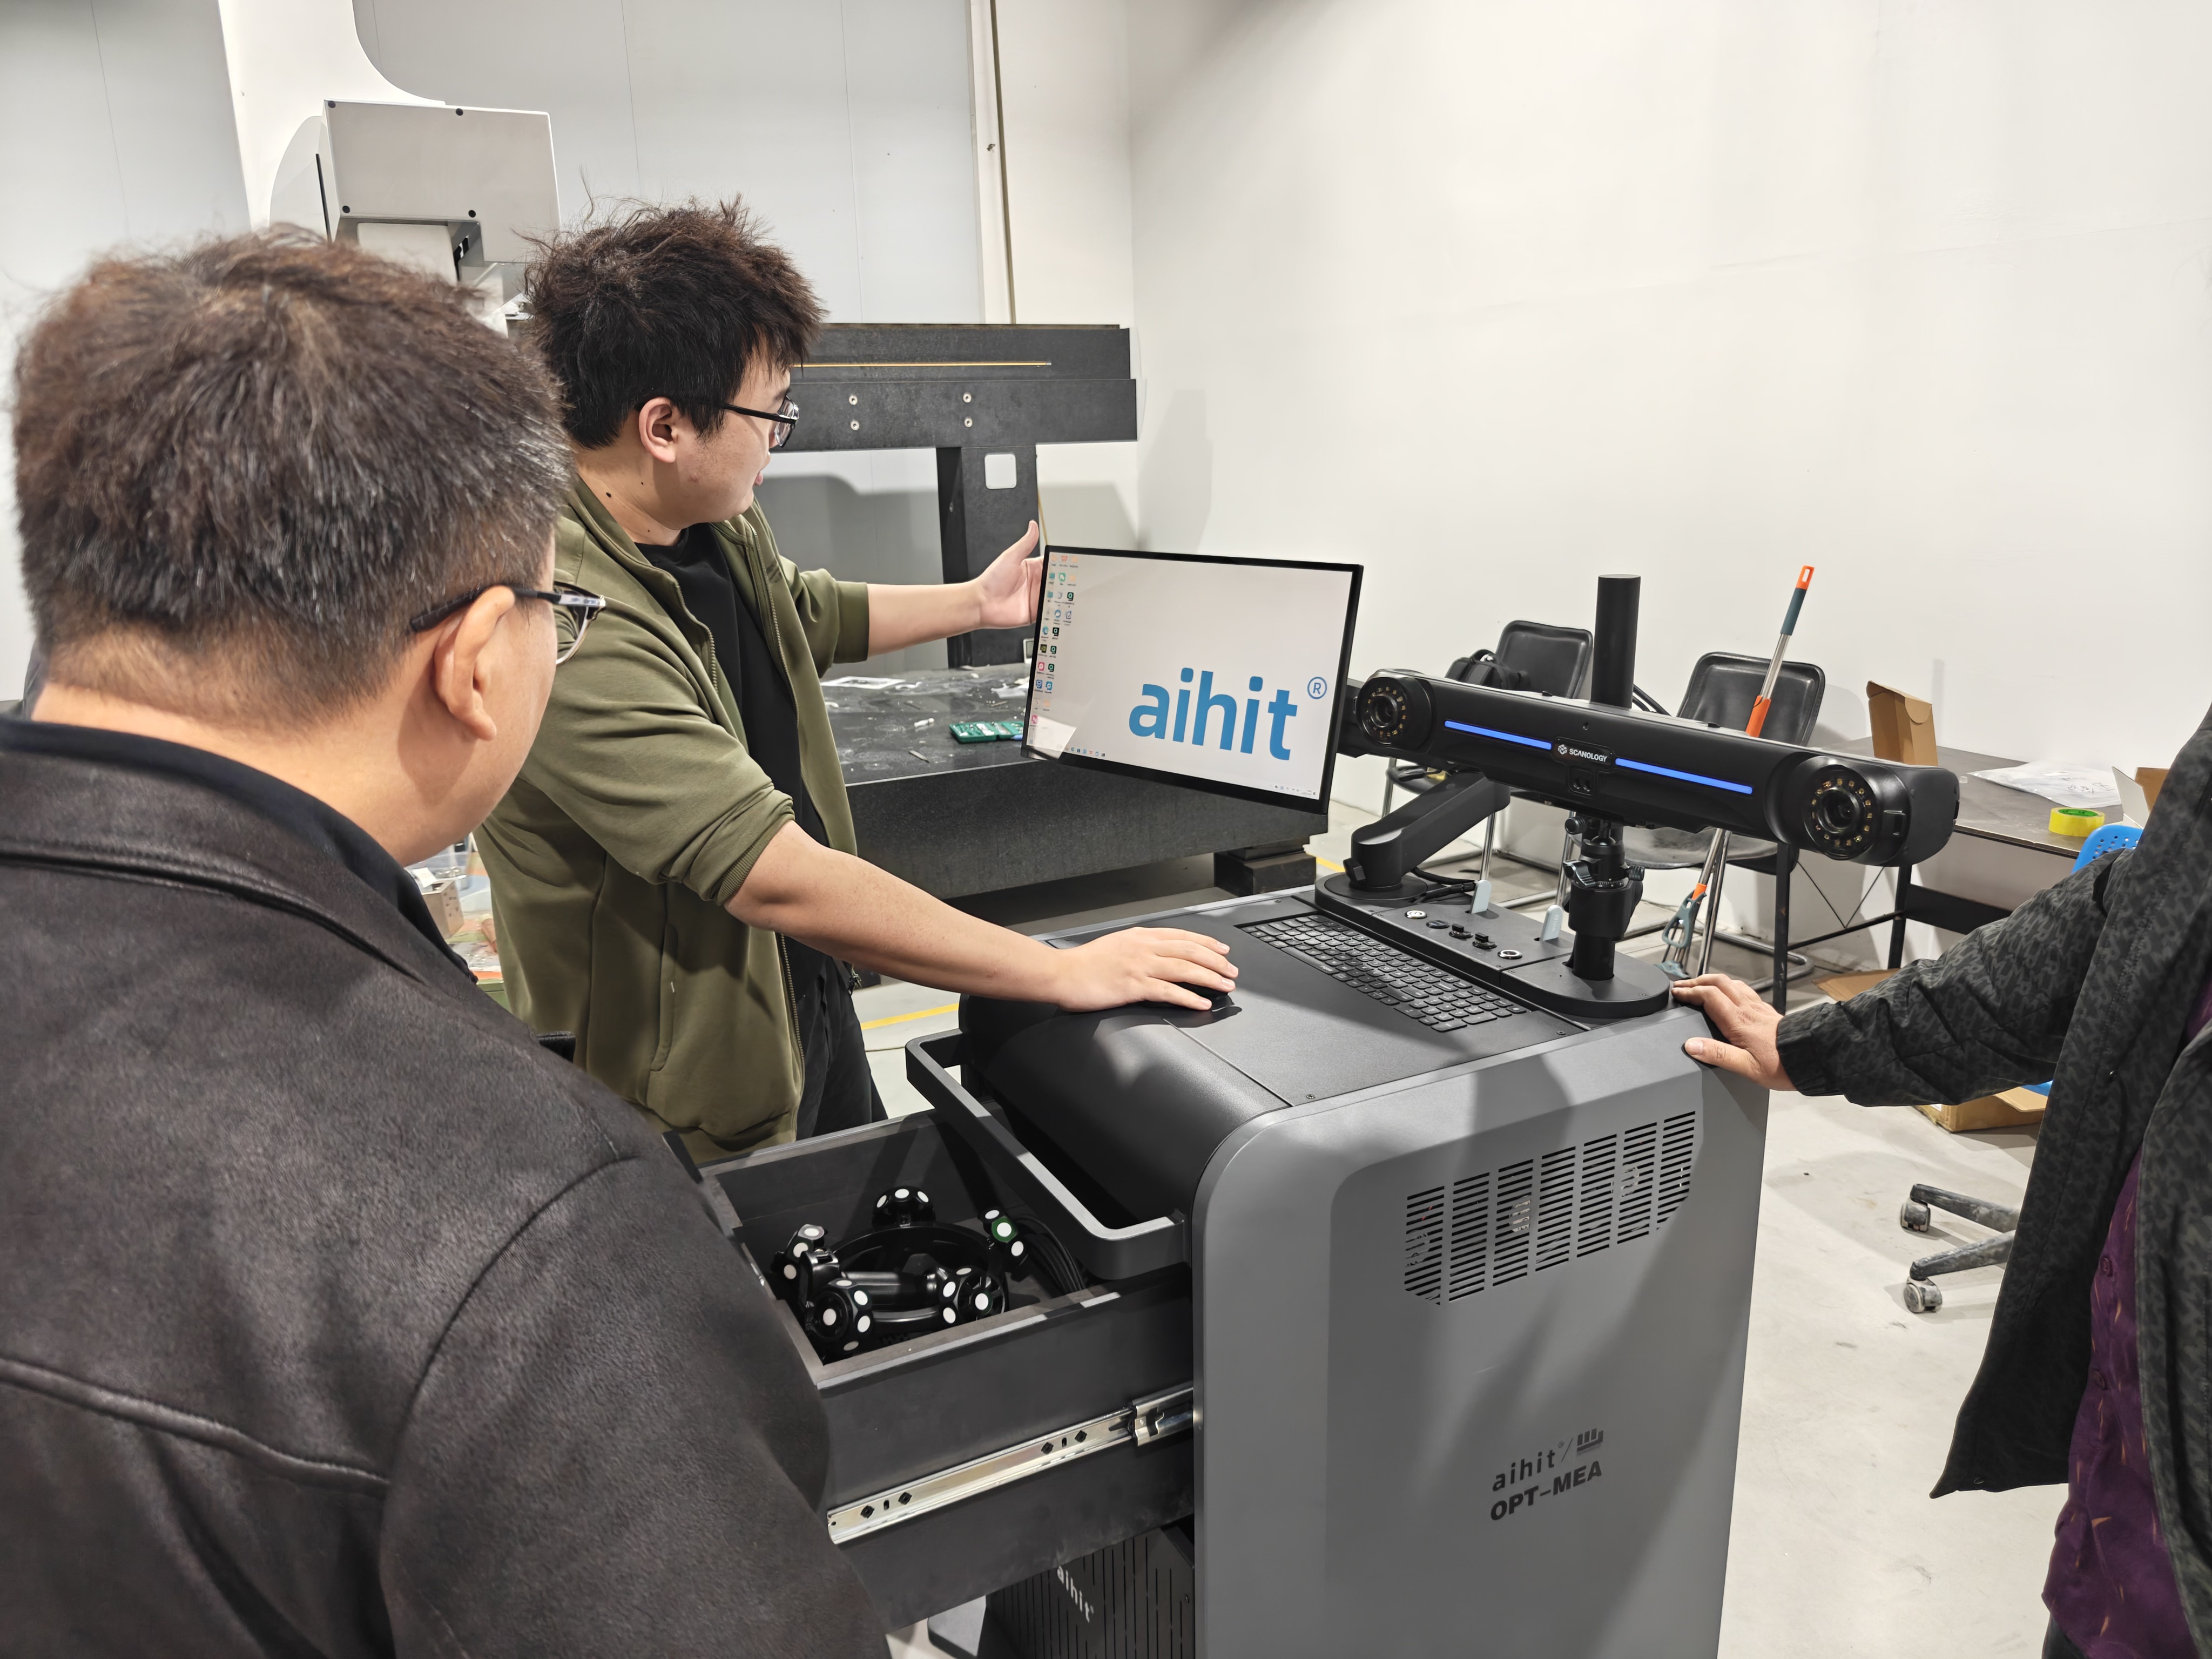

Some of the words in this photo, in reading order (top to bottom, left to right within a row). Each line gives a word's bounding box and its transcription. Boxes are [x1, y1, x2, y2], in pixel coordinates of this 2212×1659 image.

[1129, 667, 1298, 761] aihit
[1568, 748, 1608, 763] SCANOLOGY
[1490, 1460, 1602, 1521] OPT-MEA
